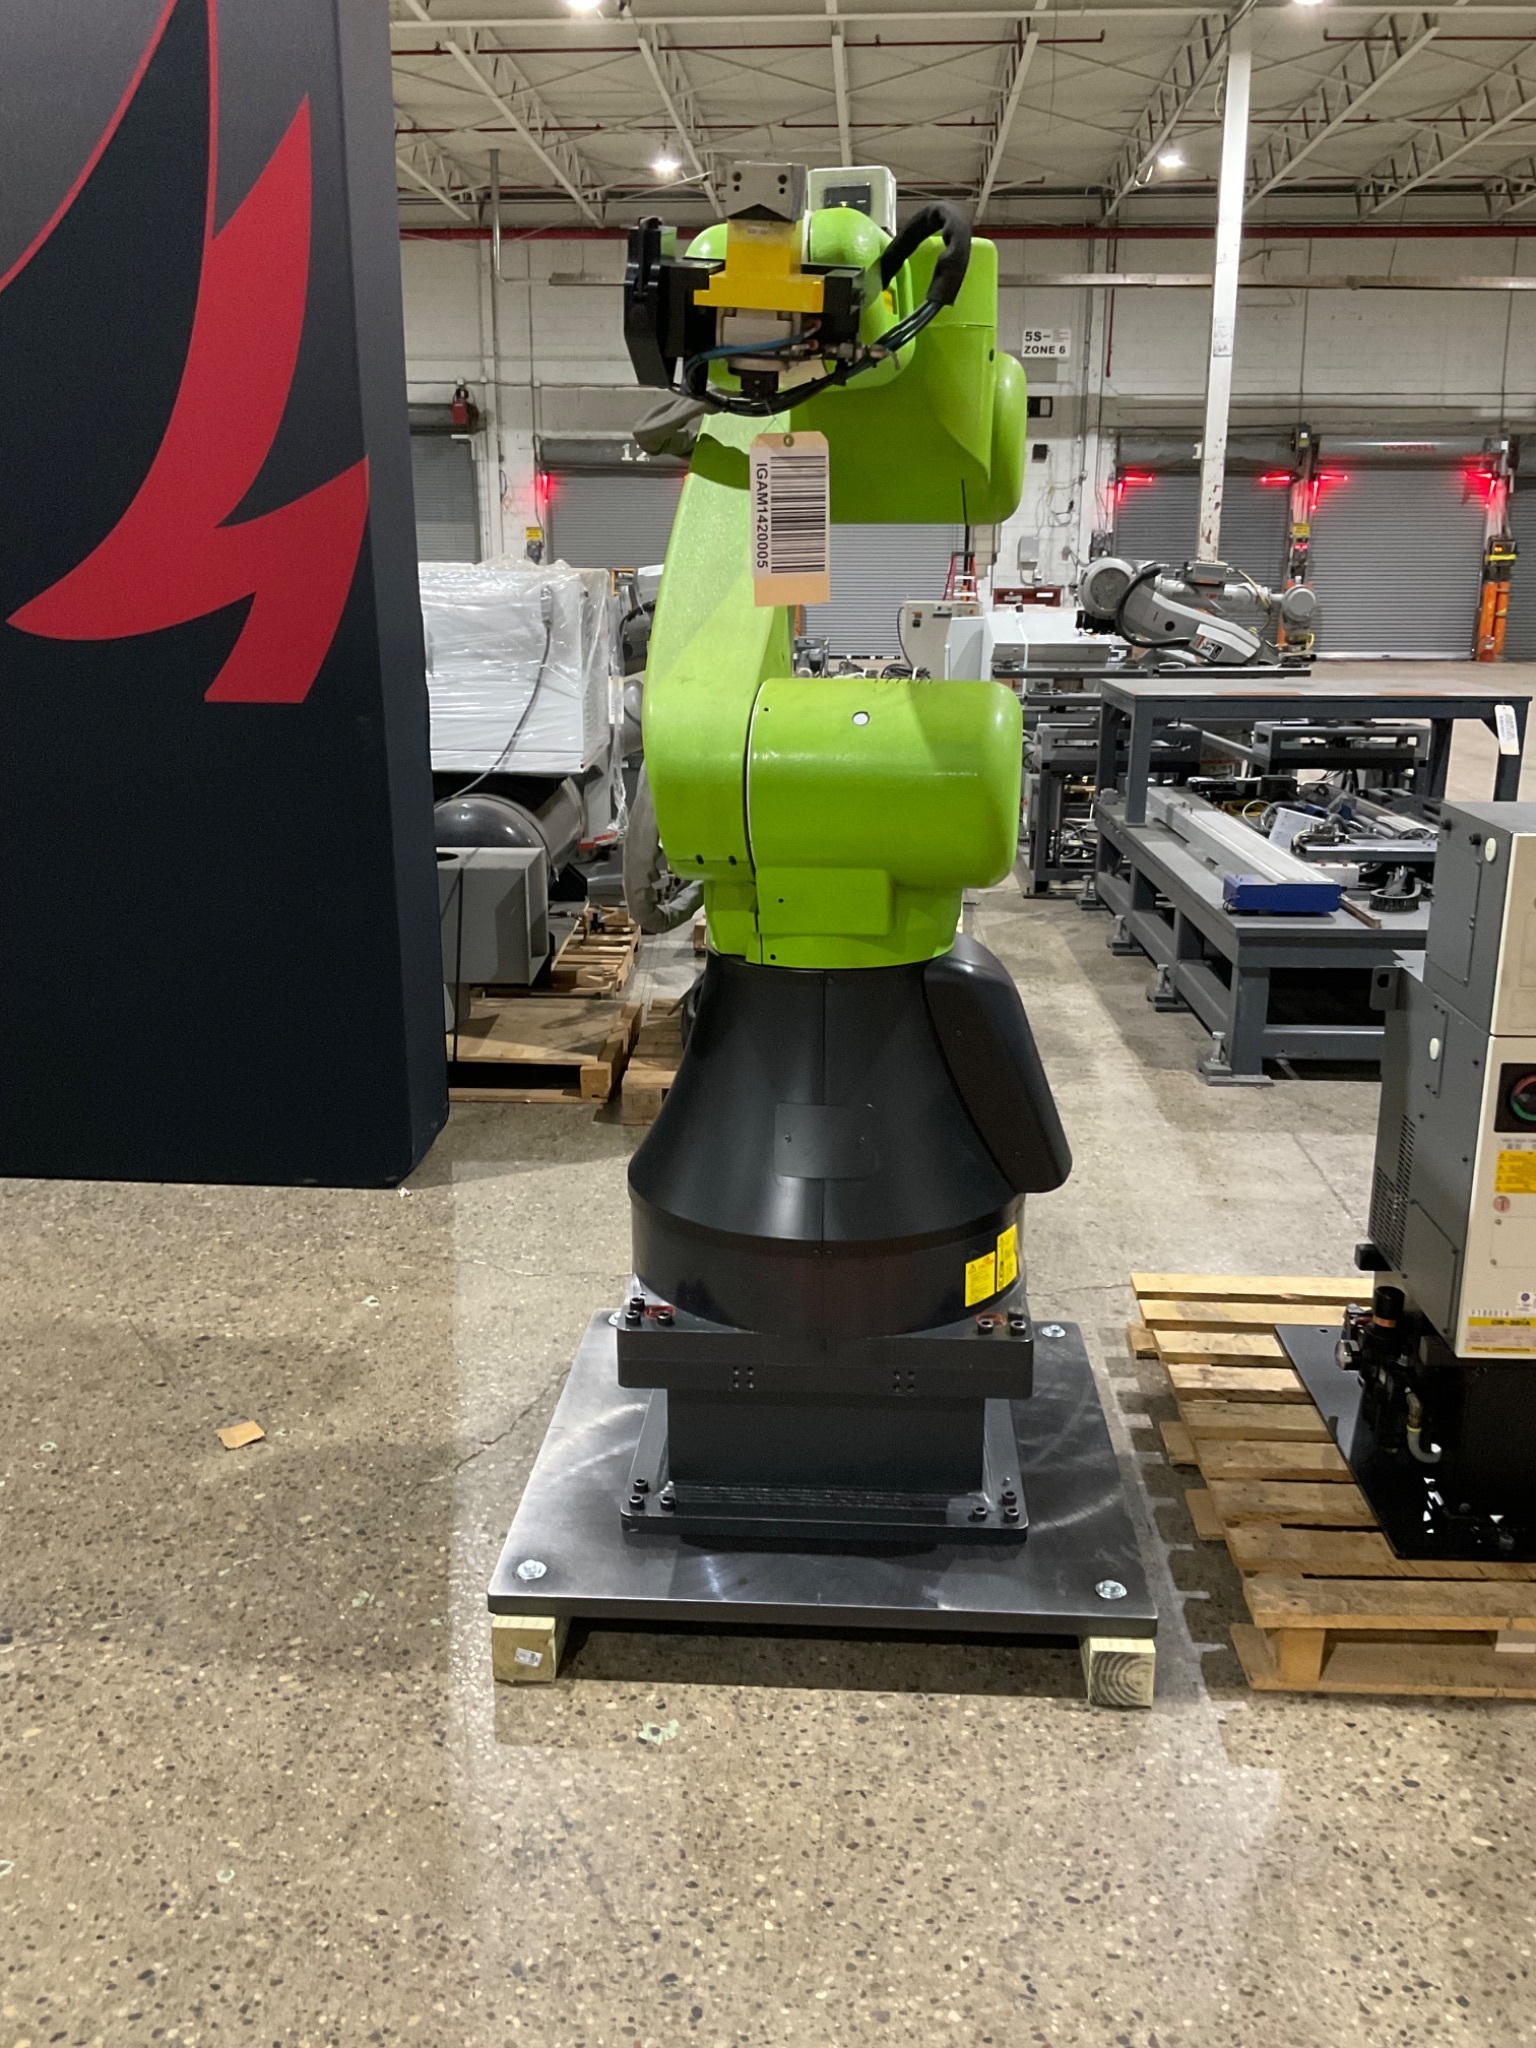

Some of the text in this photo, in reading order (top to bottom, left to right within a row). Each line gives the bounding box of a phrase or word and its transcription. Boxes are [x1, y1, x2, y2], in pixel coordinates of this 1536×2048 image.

[1025, 331, 1051, 342] 5S-
[1024, 345, 1066, 354] ZONE 6
[756, 463, 768, 568] IGAM1420005
